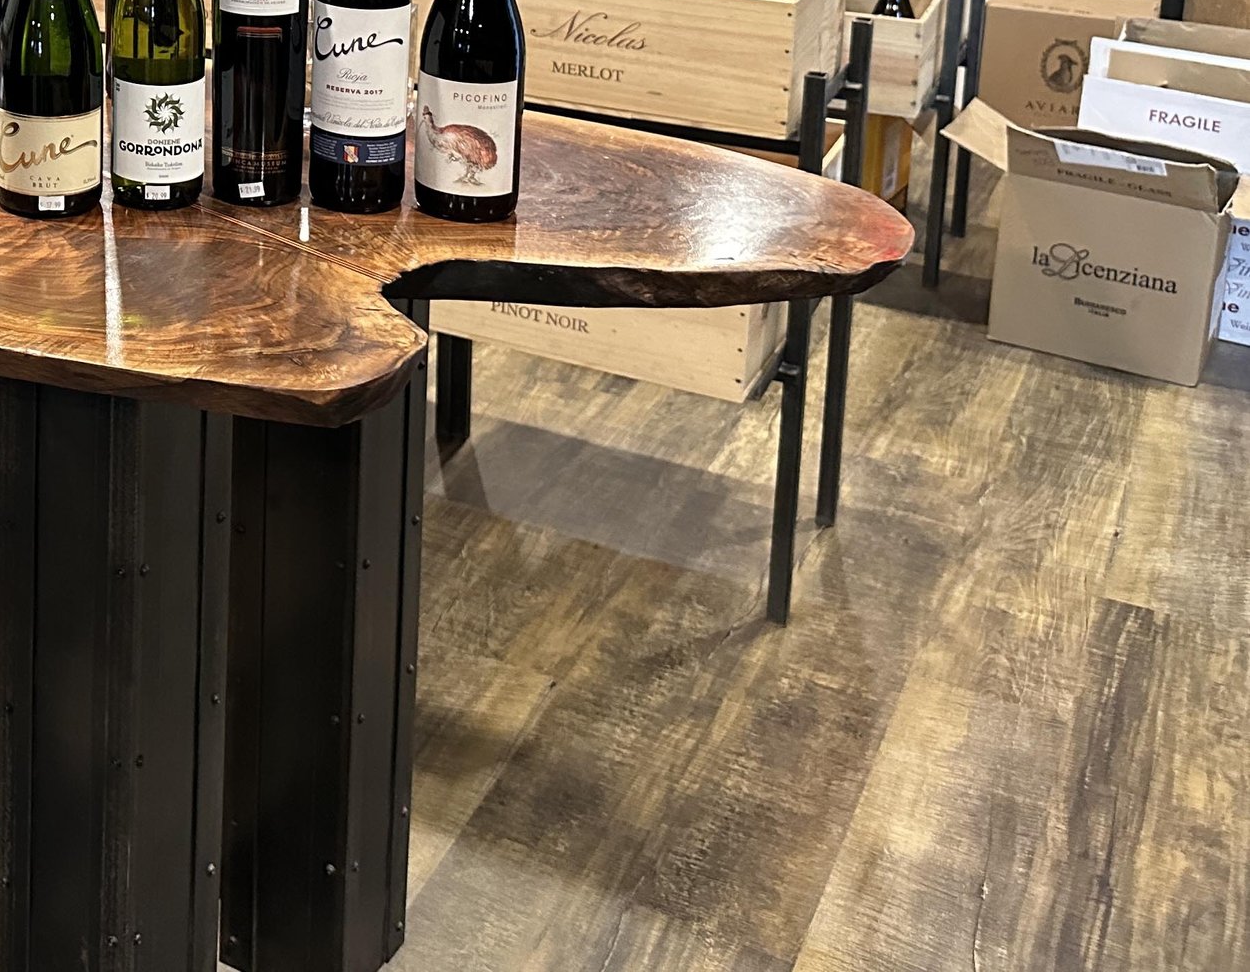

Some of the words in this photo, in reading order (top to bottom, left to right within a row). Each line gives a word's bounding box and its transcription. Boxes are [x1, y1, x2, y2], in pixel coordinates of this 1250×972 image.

[315, 16, 403, 61] Cune
[530, 10, 647, 50] Nicolas
[336, 68, 368, 84] Rioja
[552, 61, 624, 82] MERLOT
[326, 84, 362, 95] RESERVA
[453, 92, 508, 103] PICOFINO
[1149, 109, 1222, 133] FRAGILE
[119, 138, 203, 156] GORRONDONA
[491, 301, 543, 323] PINOT
[545, 312, 590, 334] NOIR
